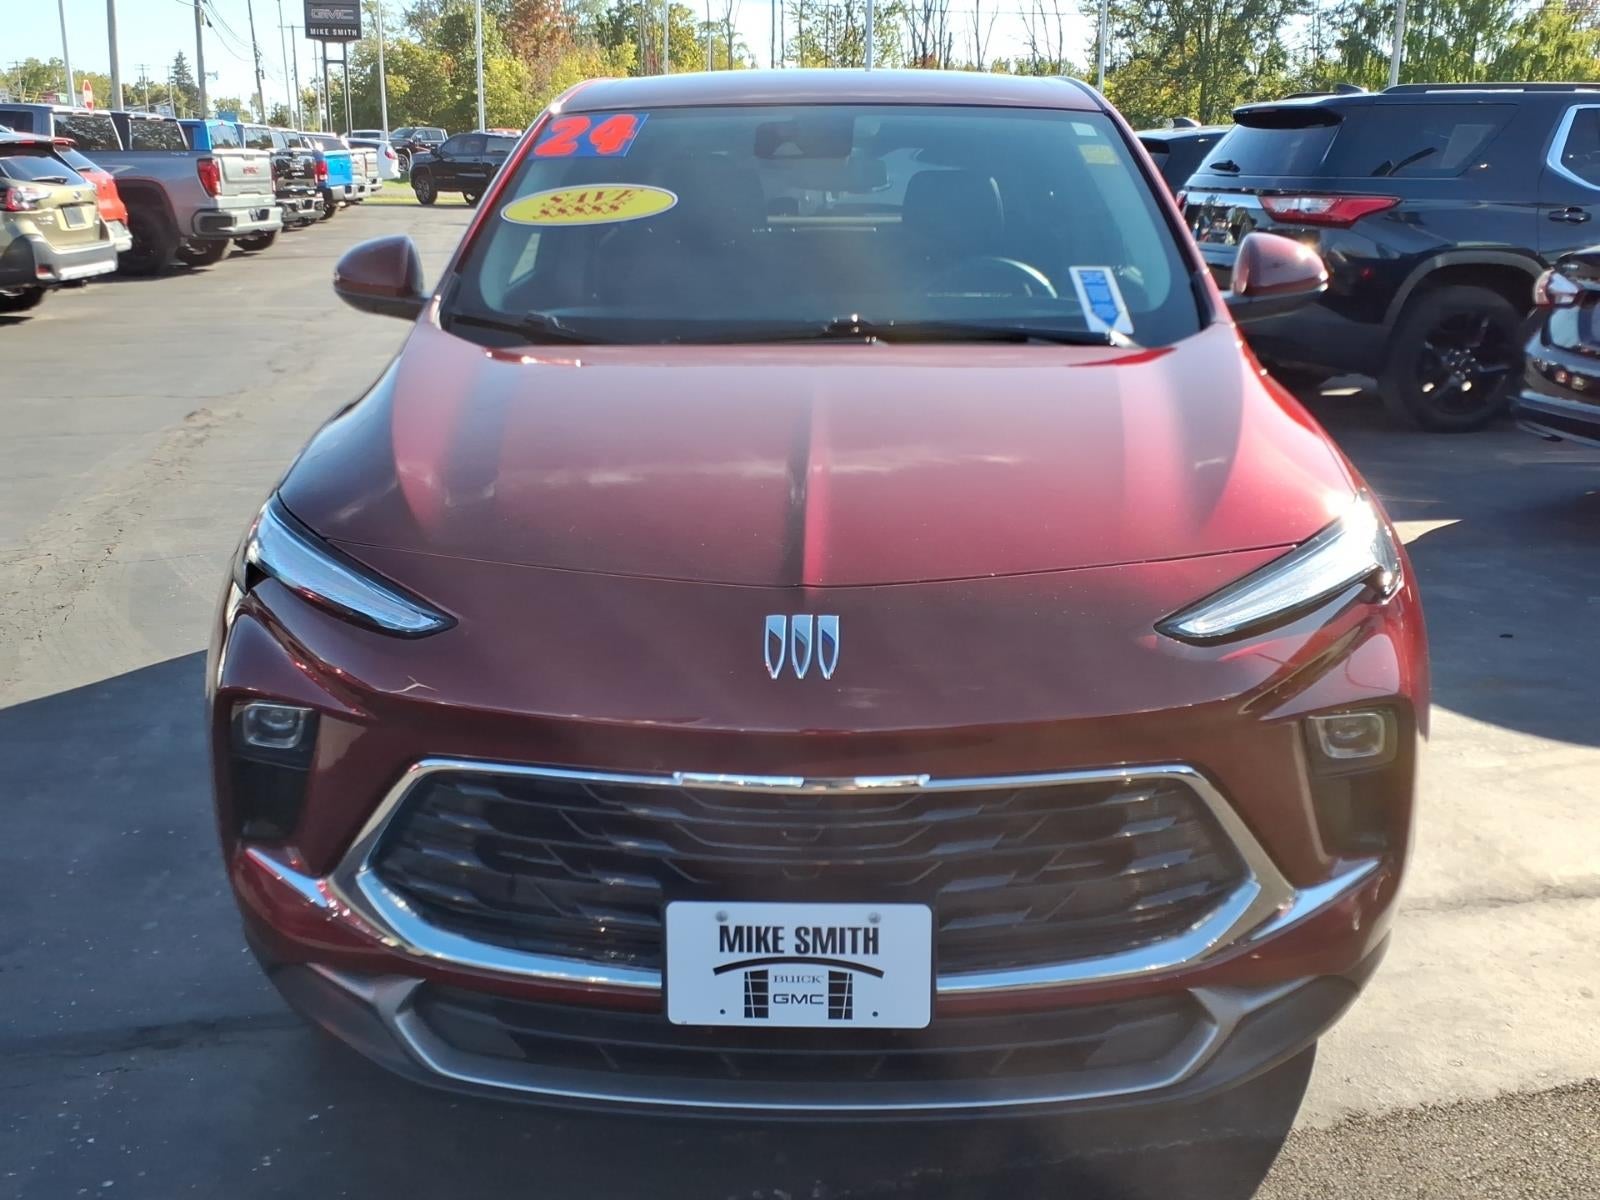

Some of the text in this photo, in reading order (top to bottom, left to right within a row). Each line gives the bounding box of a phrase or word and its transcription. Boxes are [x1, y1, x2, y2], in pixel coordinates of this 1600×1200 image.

[311, 9, 353, 19] GMC
[310, 28, 357, 36] MIKE SMITH
[535, 115, 637, 156] 24
[719, 925, 879, 955] MIKE SMITH
[773, 974, 824, 984] BUICK
[772, 993, 824, 1005] GMC
